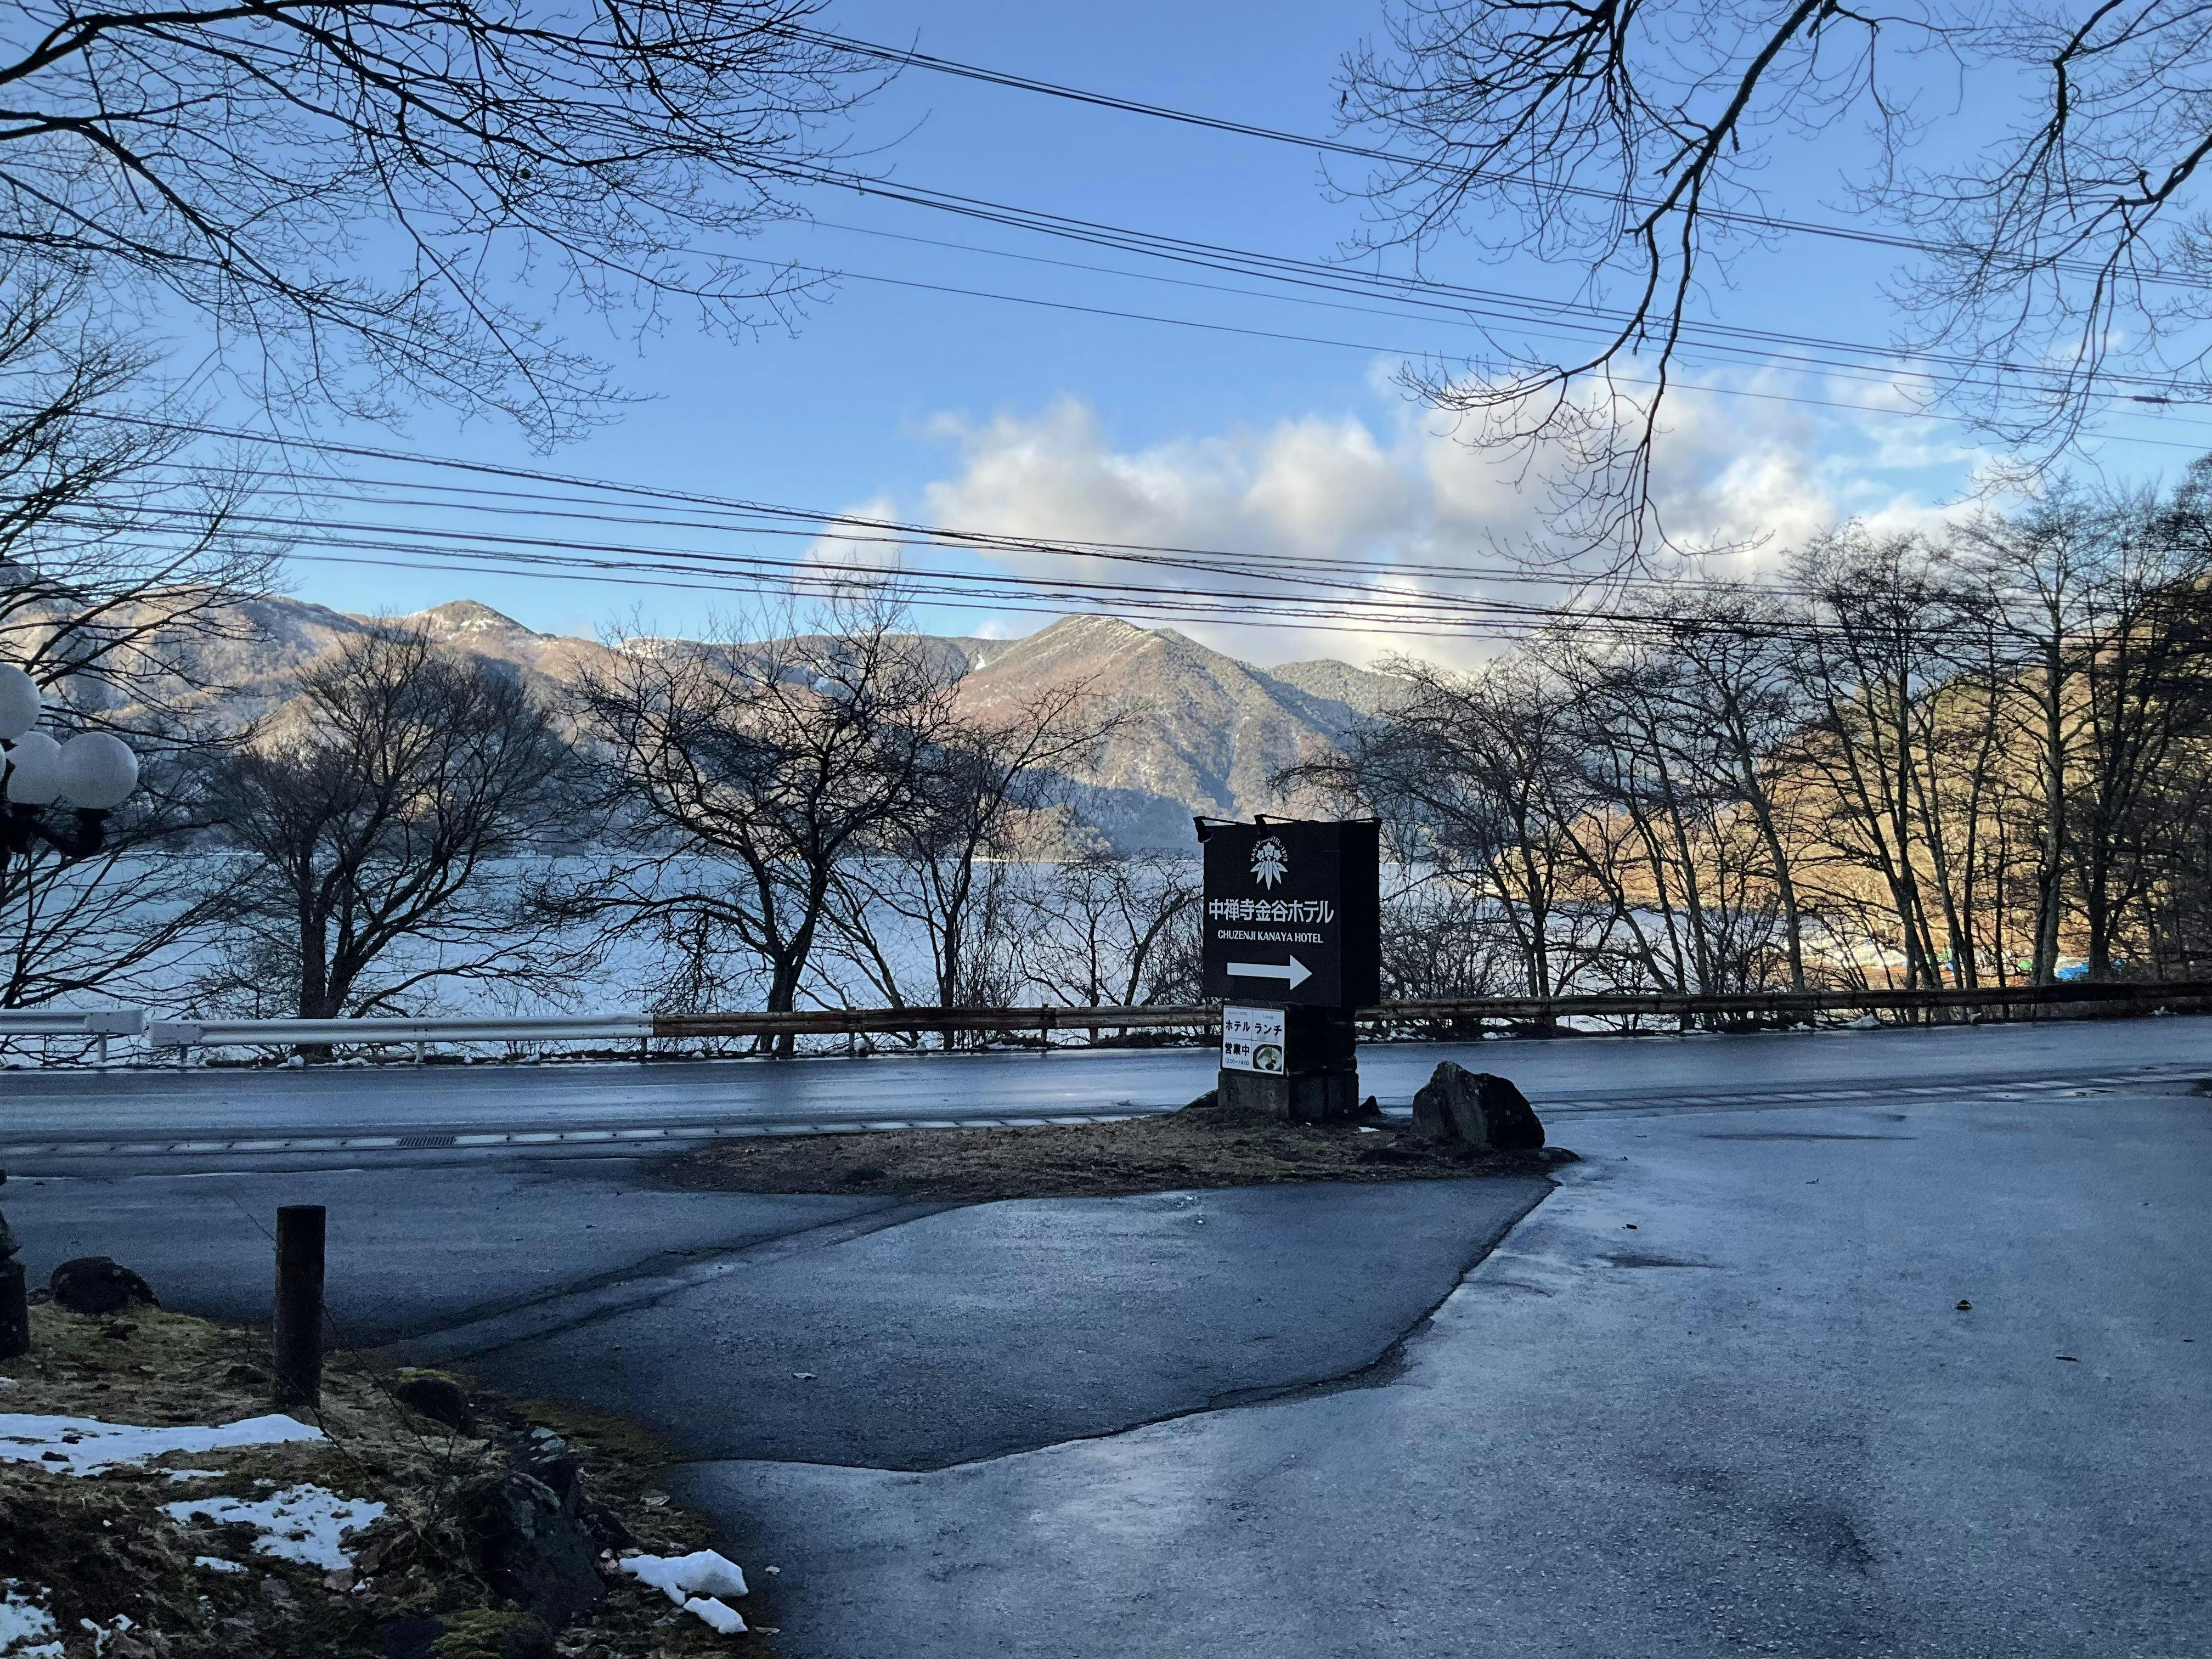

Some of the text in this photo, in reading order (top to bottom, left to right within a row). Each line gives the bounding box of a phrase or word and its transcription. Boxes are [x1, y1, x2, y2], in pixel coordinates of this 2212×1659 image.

[1209, 899, 1334, 923] 中禅寺金谷ホテル
[1217, 929, 1324, 943] CHUZENJI KANAYA HOTEL
[1225, 1020, 1282, 1036] ホテル ランチ
[1224, 1042, 1250, 1056] 営業中
